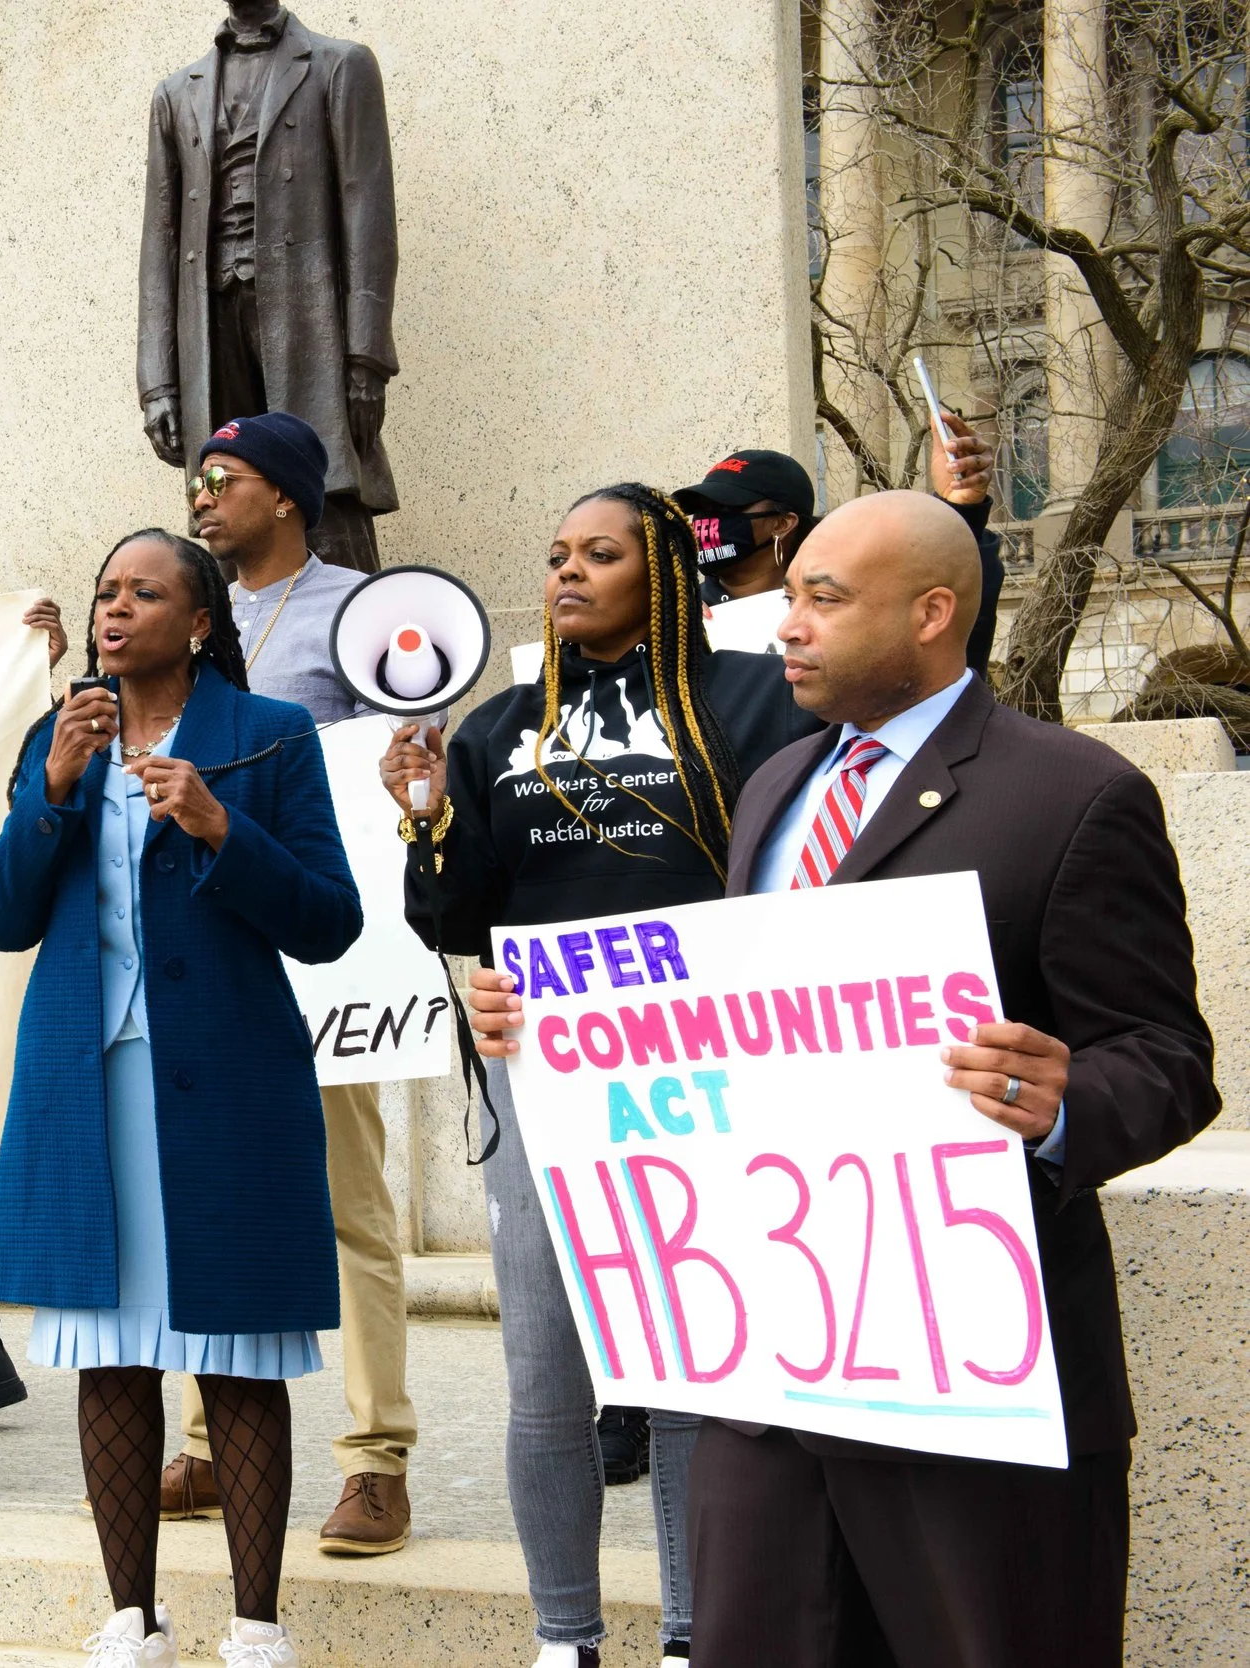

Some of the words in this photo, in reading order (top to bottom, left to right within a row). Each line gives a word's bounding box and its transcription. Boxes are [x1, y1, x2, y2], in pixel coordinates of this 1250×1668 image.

[605, 770, 678, 789] Center
[530, 823, 591, 845] Racial
[596, 819, 664, 844] Justice
[556, 790, 616, 833] for
[502, 920, 690, 1000] SAFER
[537, 971, 995, 1074] COMMUNITIES
[607, 1069, 732, 1143] ACT
